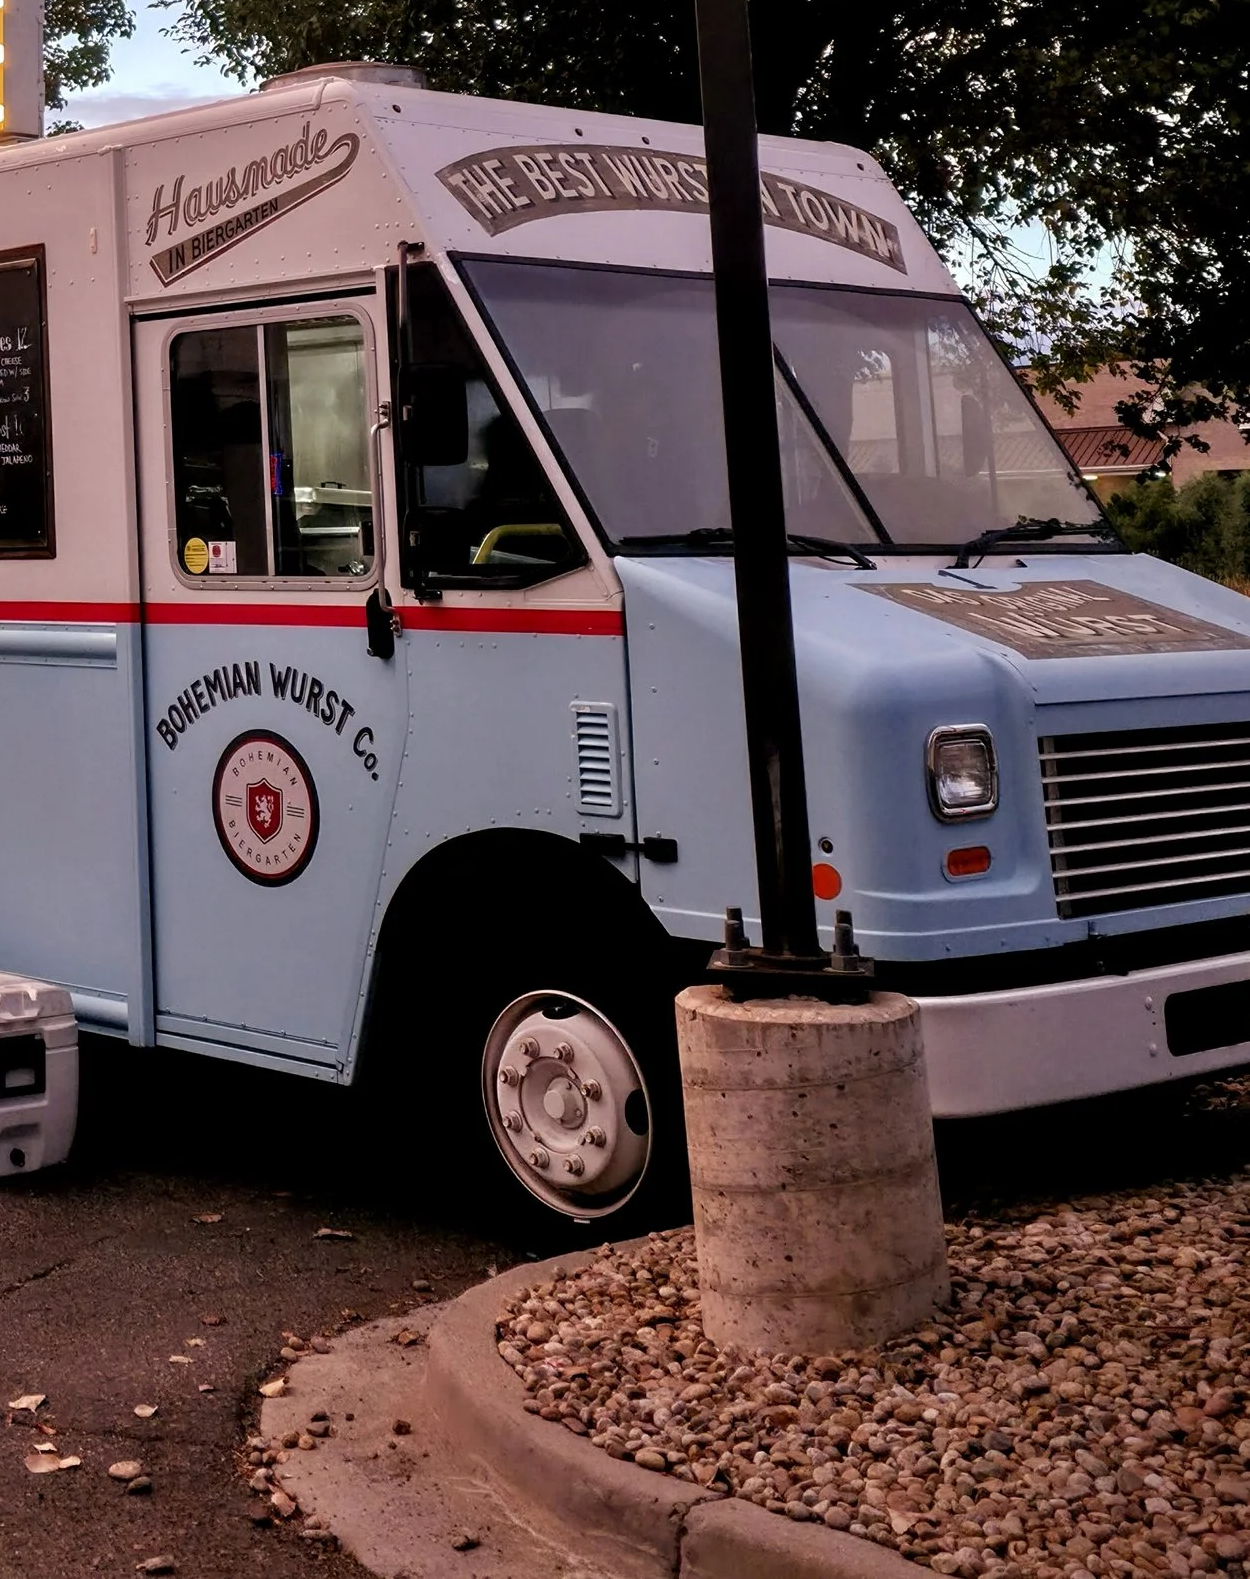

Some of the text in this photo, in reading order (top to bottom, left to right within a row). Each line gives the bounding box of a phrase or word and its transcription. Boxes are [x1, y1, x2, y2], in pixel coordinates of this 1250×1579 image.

[145, 121, 336, 246] Hausmade
[448, 159, 531, 218] THE
[514, 152, 612, 200] BEST
[776, 182, 890, 257] TOWN
[168, 197, 280, 274] IN BIERGARTEN
[156, 661, 261, 751] BOHEMIAN
[270, 662, 356, 736] WURST
[232, 750, 298, 786] BOHEMIAN
[228, 820, 301, 866] BIERGARTEN
